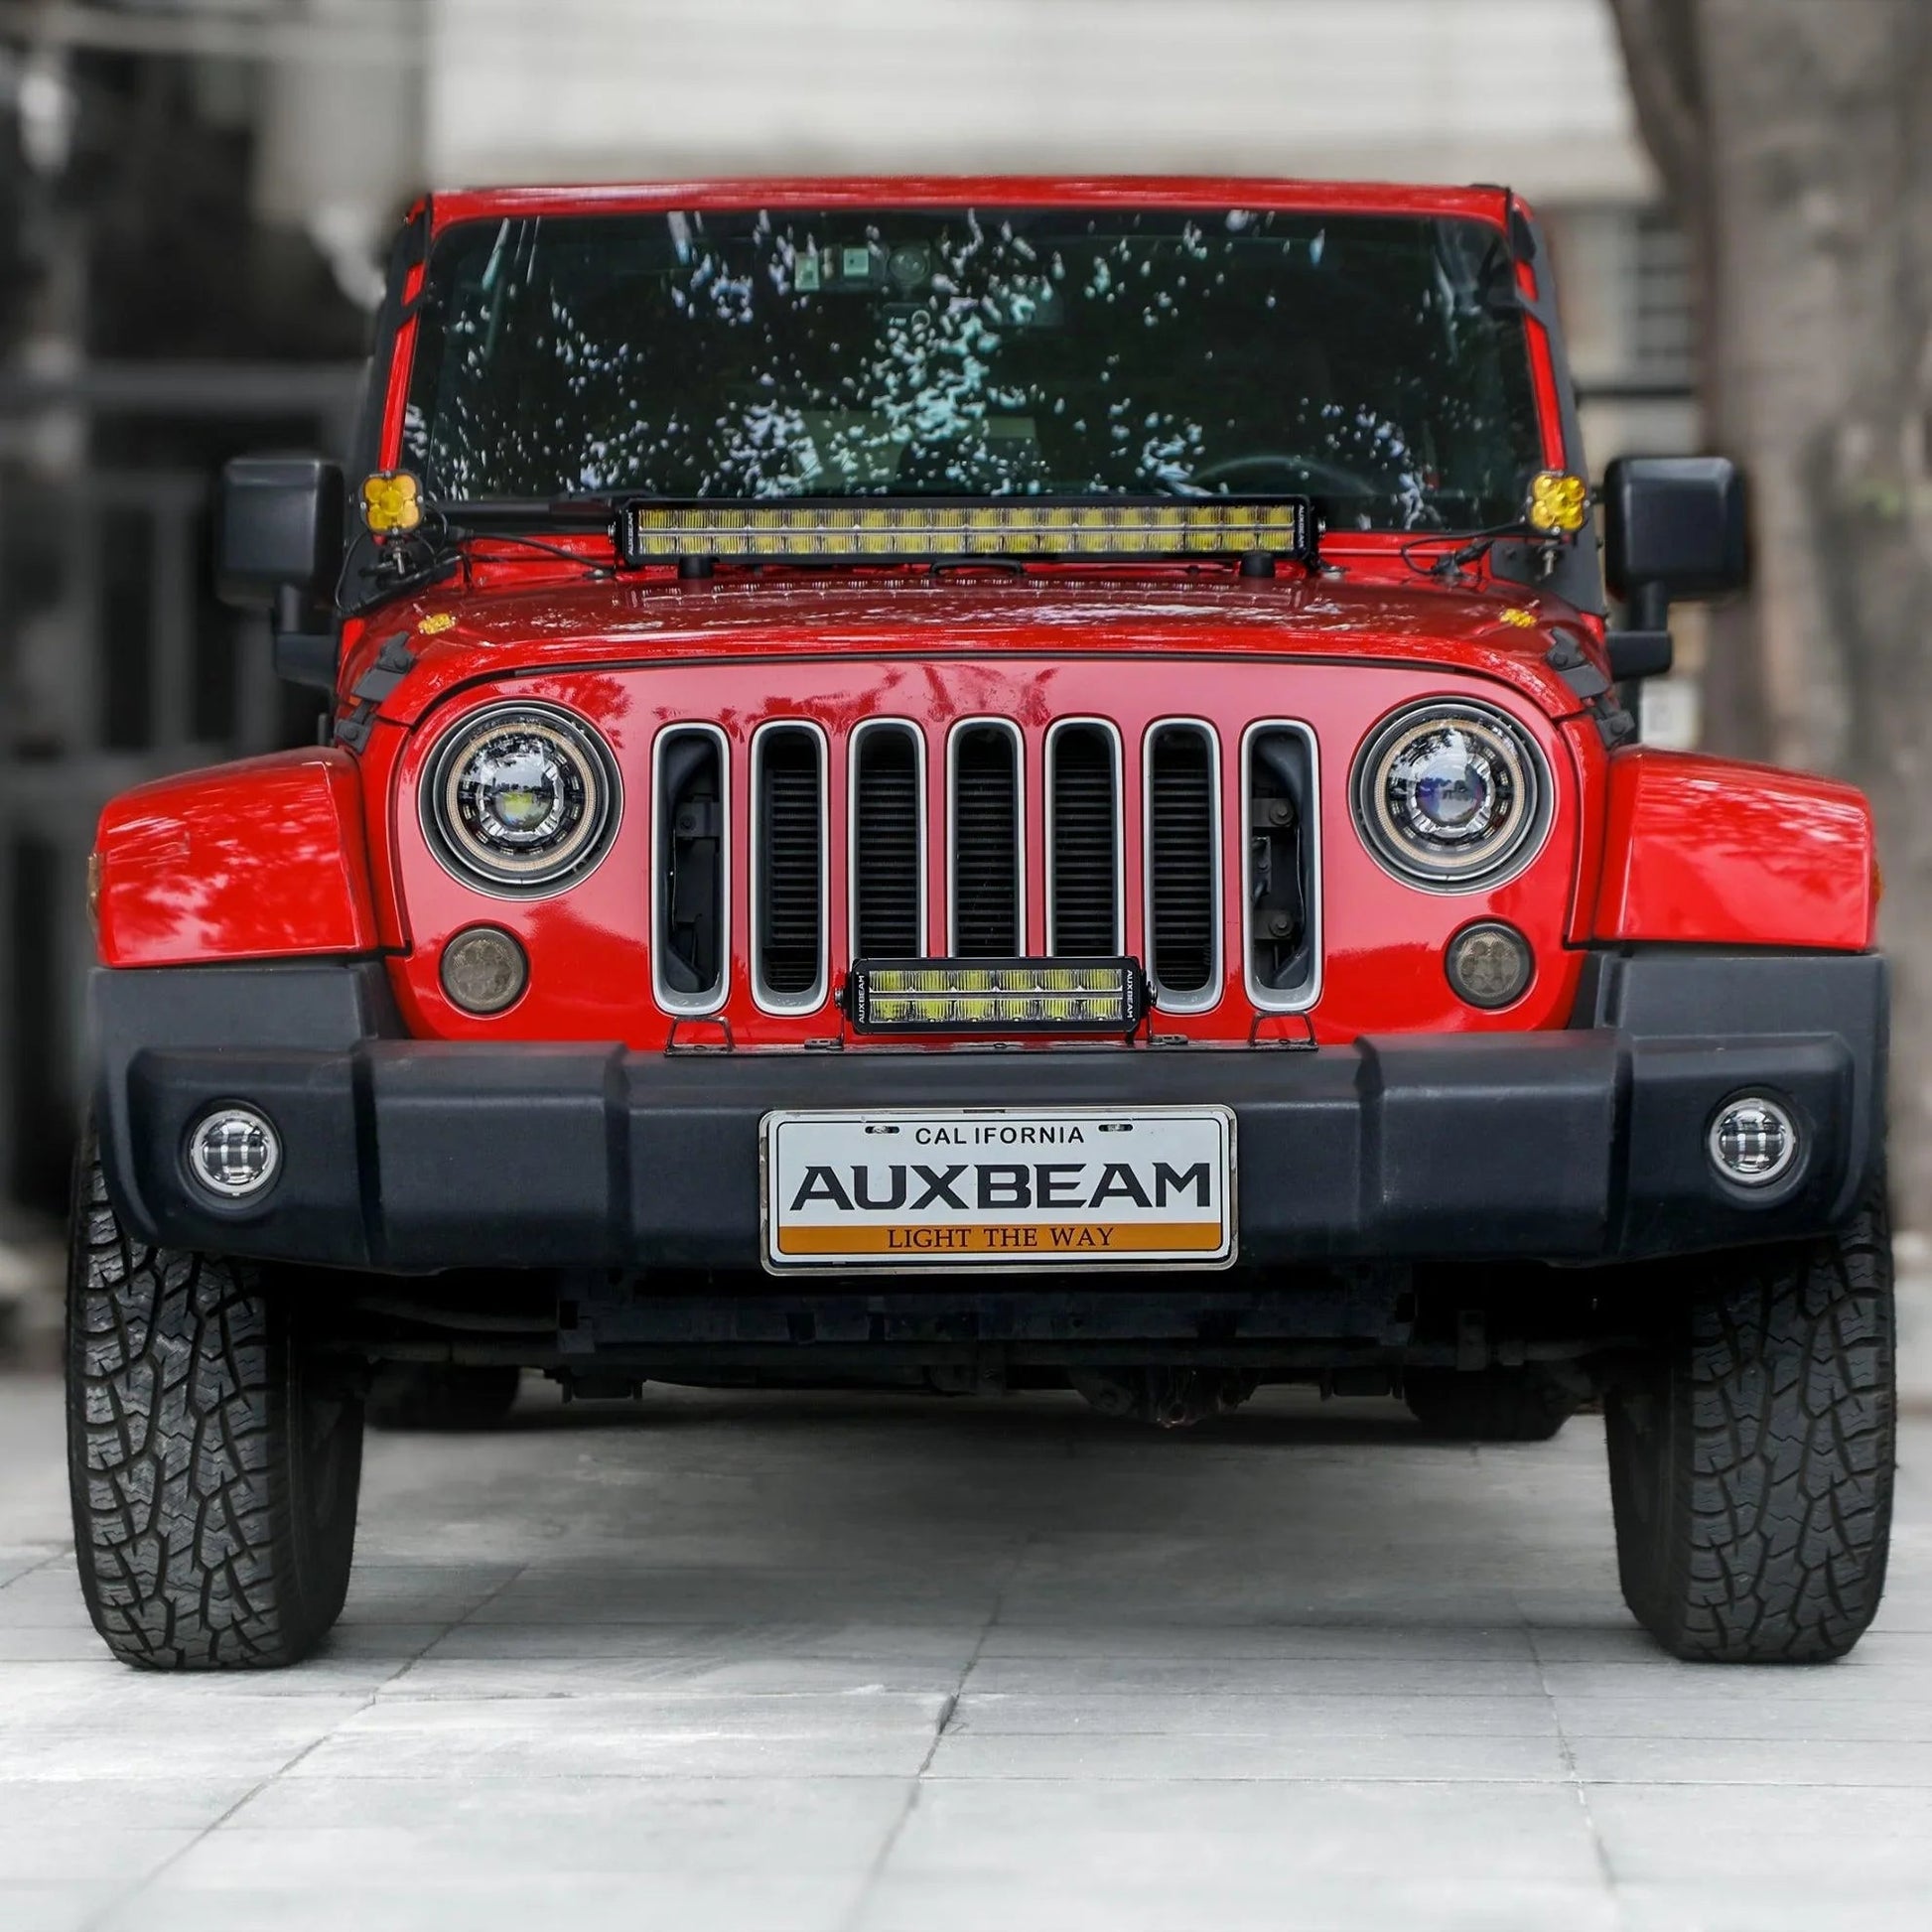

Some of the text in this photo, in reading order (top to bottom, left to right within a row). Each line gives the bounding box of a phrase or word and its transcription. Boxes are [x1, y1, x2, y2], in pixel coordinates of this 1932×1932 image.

[915, 1126, 1085, 1145] CALIFORNIA
[789, 1163, 1211, 1211] AUXBEAM
[887, 1226, 1115, 1248] LIGHT THE WAY
